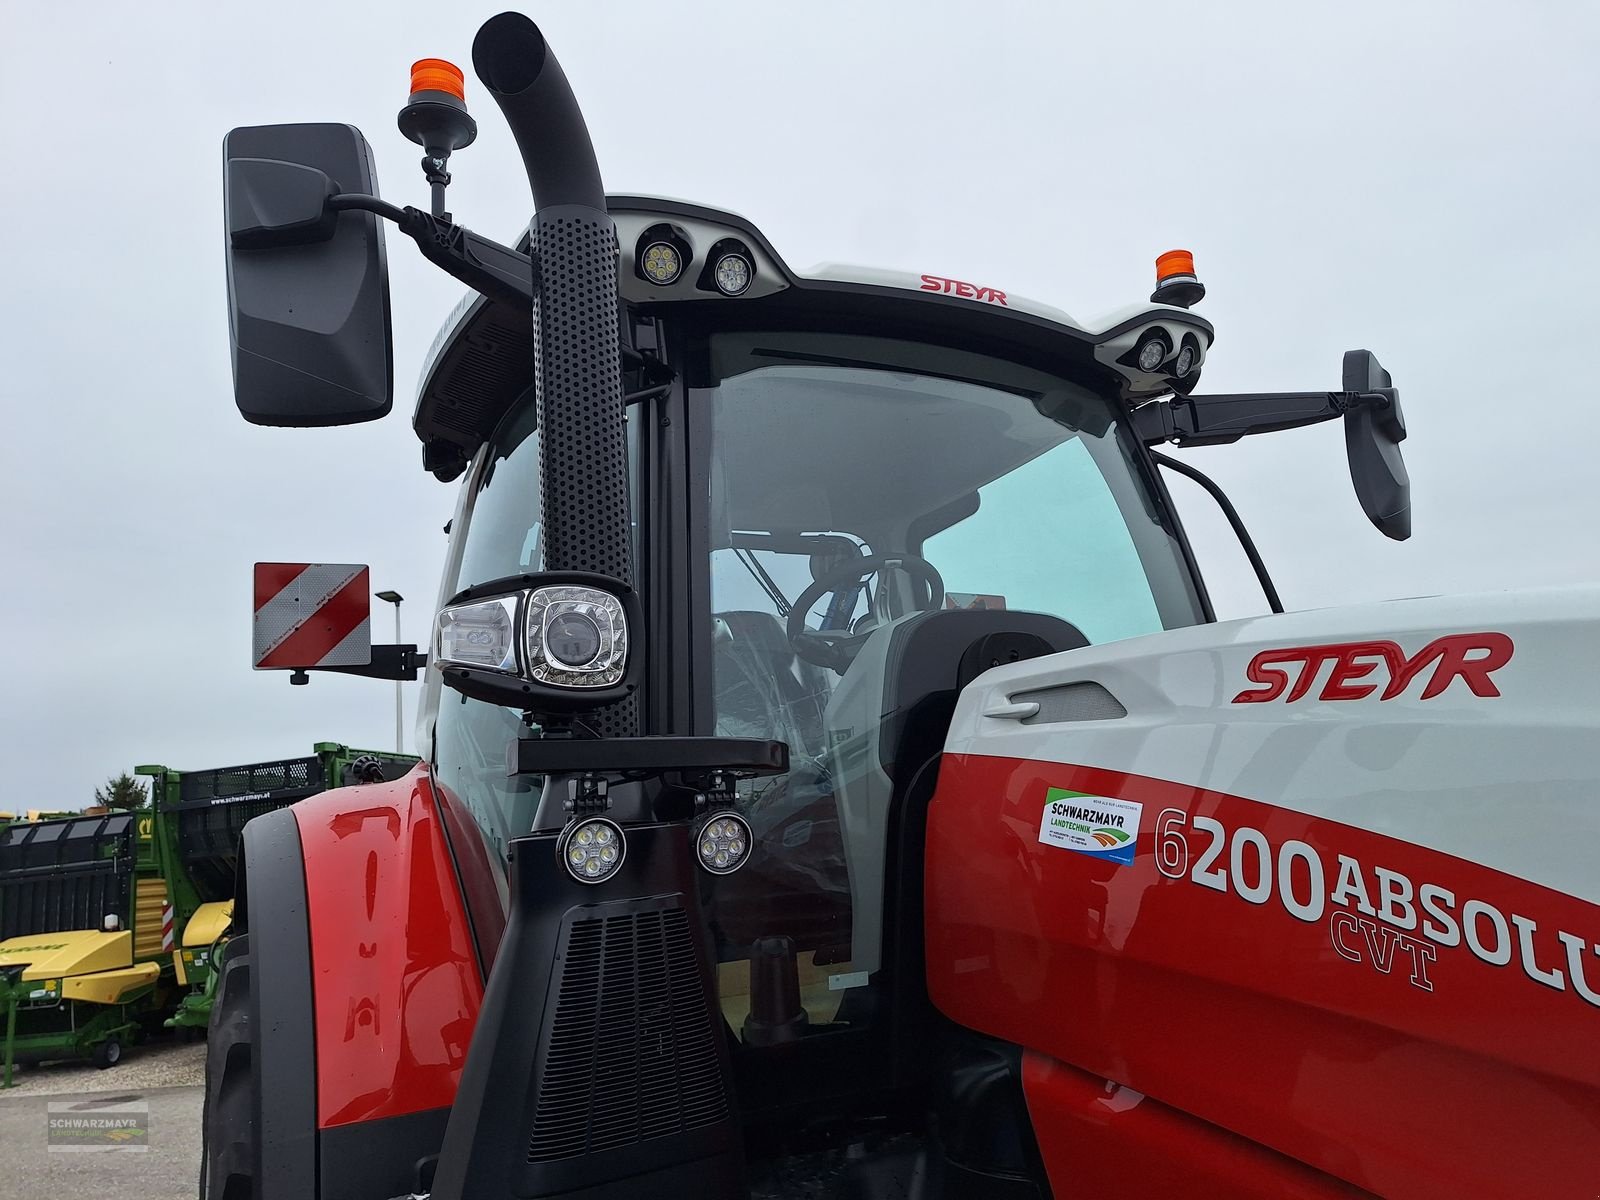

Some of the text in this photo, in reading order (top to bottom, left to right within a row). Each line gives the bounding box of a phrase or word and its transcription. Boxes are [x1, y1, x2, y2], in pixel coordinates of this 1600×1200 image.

[920, 274, 1008, 306] STEYR
[1230, 631, 1515, 704] STEYR
[210, 791, 271, 806] www.schwarzmayr.at
[1050, 817, 1091, 834] LANDTECHNIK
[1051, 802, 1125, 828] SCHWARZMAYR
[1154, 807, 1326, 923] 6200
[1329, 910, 1438, 992] CVT
